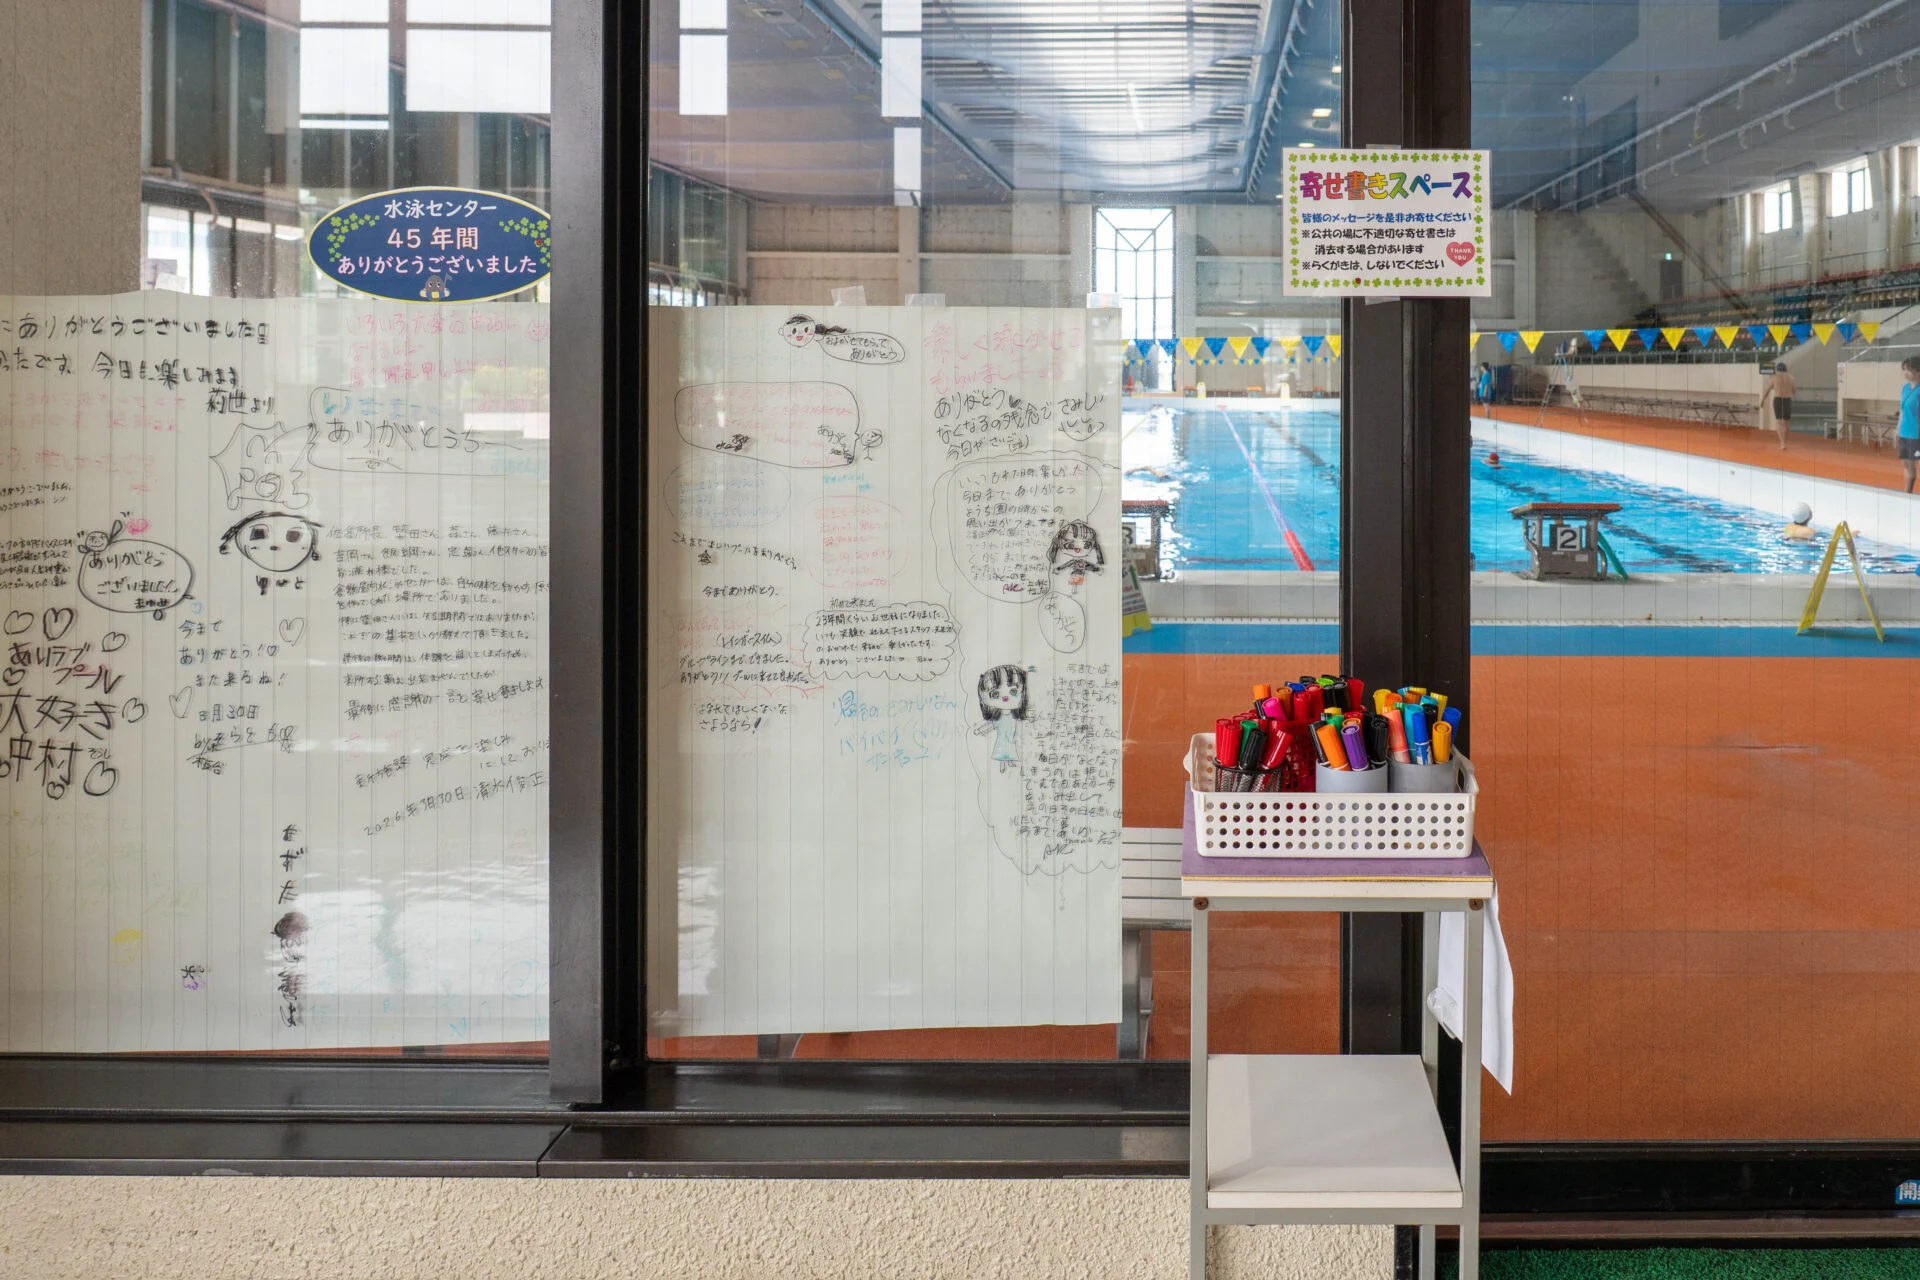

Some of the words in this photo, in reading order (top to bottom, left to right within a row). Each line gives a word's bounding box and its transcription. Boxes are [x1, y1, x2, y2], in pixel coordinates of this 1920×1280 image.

[1300, 171, 1473, 201] 寄せ書きスペース
[384, 199, 497, 218] 水泳センター
[1301, 213, 1472, 223] 皆様のメッセージを是非お寄せください
[1301, 228, 1457, 239] ※公共の場に不適切な寄せ書きは
[1315, 245, 1425, 255] 消去する場合があります
[337, 255, 538, 275] ありがとうございました
[1302, 260, 1445, 271] ※らくがきは、しないでください
[1559, 529, 1578, 549] 2
[0, 687, 118, 740] 大好き
[1899, 1182, 1920, 1201] 開
